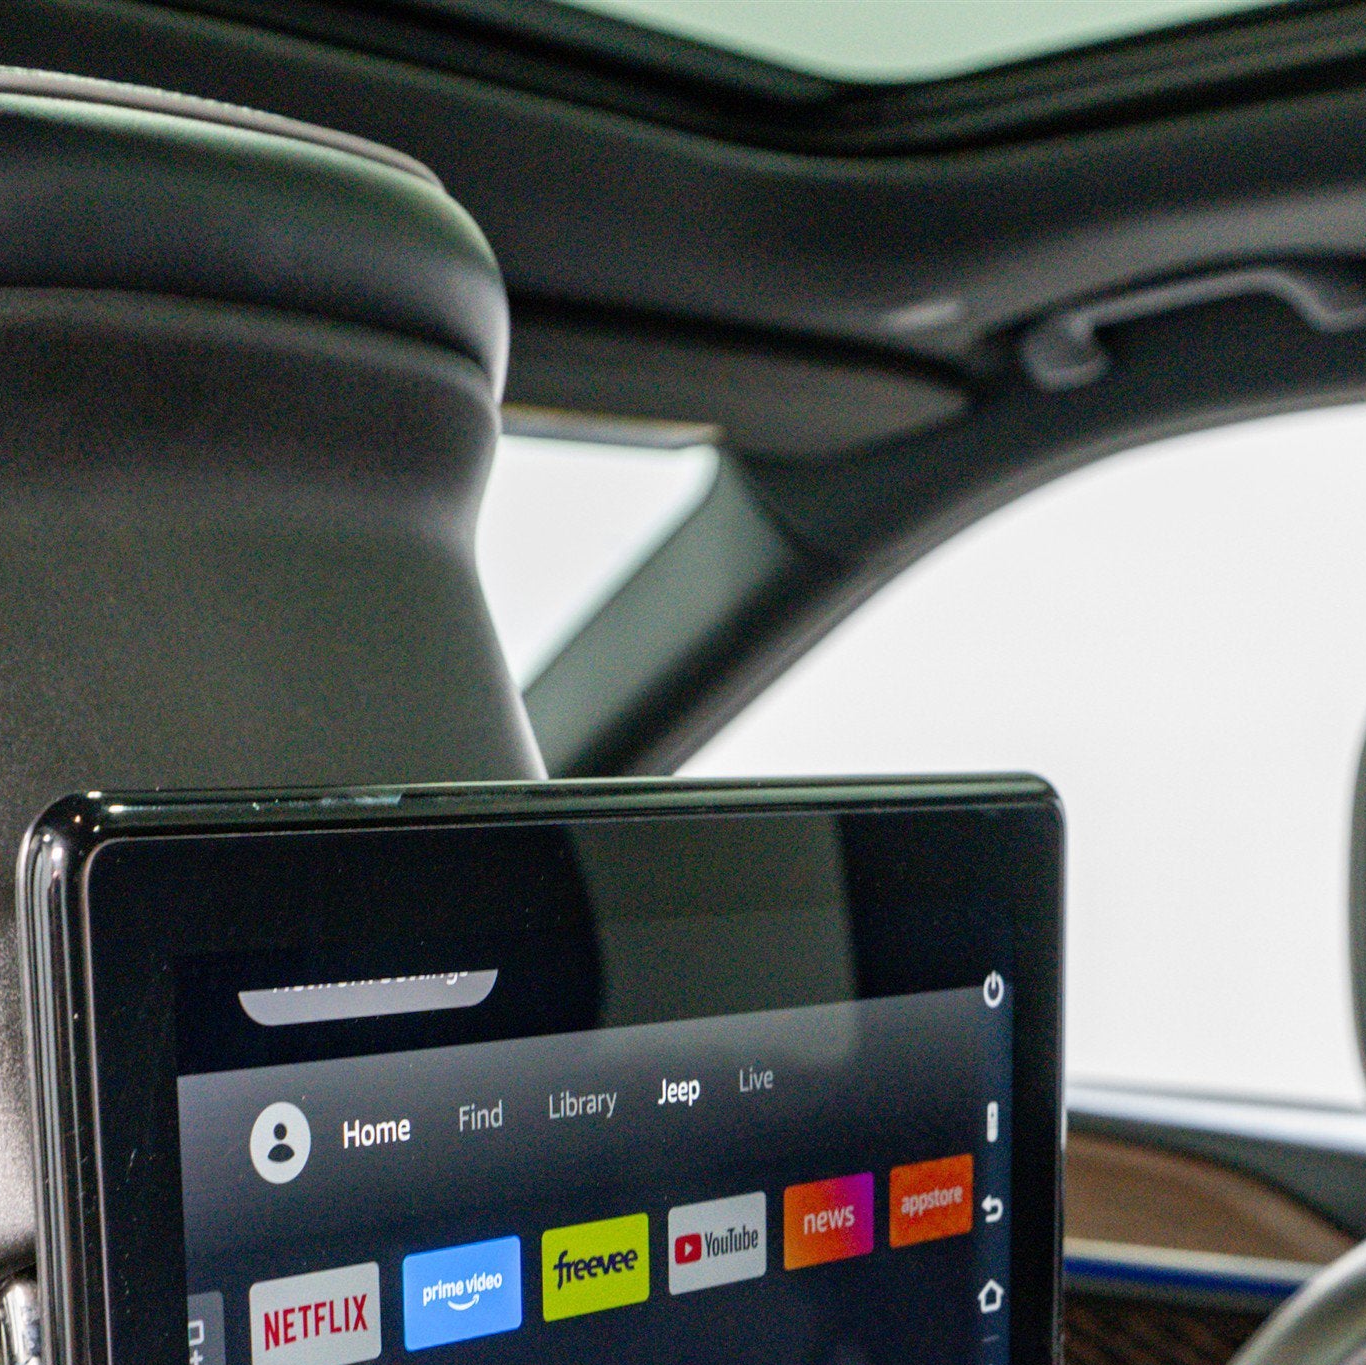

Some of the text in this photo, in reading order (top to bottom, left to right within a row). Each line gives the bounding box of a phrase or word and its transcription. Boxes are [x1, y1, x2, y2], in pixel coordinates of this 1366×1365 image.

[343, 1068, 774, 1149] Home Find Library Jeep Live
[900, 1185, 963, 1217] appstore
[803, 1205, 855, 1235] news
[704, 1224, 759, 1258] YouTube
[552, 1248, 639, 1290] freevee
[422, 1271, 503, 1307] prime video
[263, 1293, 368, 1352] NETFLIX
